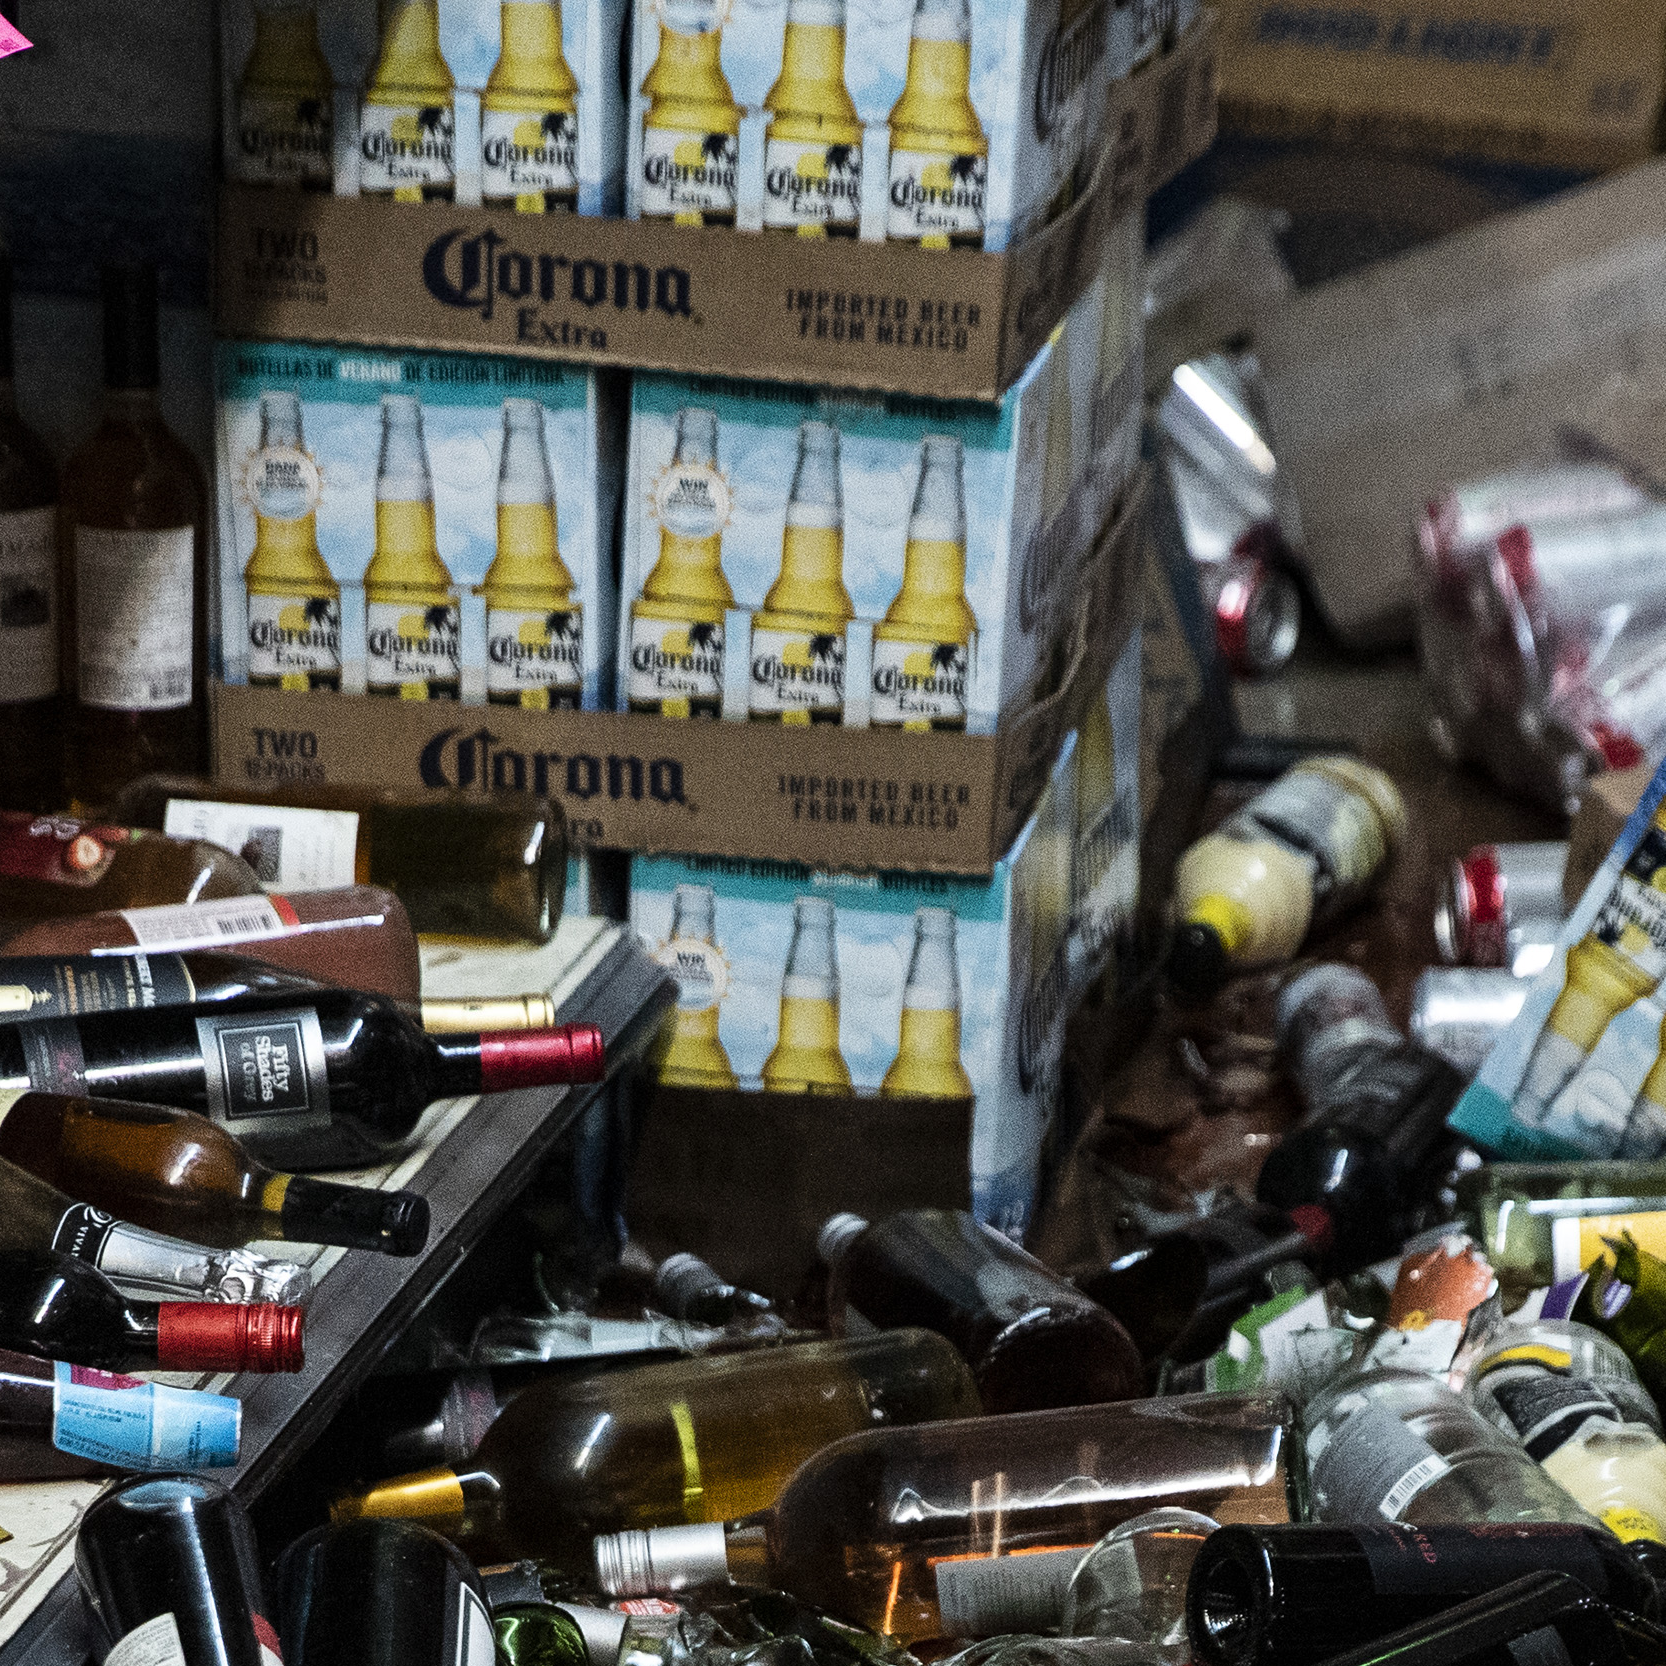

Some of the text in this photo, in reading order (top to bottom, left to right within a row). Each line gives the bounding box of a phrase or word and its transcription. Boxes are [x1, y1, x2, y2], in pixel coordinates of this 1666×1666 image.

[361, 129, 452, 162] Corona
[484, 135, 576, 167] Corona
[645, 154, 733, 189] Corona
[767, 164, 858, 198] Corona
[891, 175, 983, 207] Corona
[254, 228, 319, 258] TWO
[422, 226, 693, 321] Corona
[786, 289, 979, 326] IMPORTED BEER
[516, 306, 609, 351] Extra
[799, 316, 968, 352] FROM MEXICO
[679, 479, 708, 491] WIN
[250, 618, 339, 650] Corona
[369, 628, 458, 657] Corona
[490, 635, 579, 664] Corona
[633, 643, 721, 672] Corona
[752, 655, 842, 685] Corona
[873, 667, 963, 695] Corona
[254, 729, 317, 758] TWO
[419, 726, 687, 806] Corona
[779, 775, 970, 804] IMPORTED BEER
[794, 799, 958, 828] FROM MEXICO
[675, 951, 707, 966] WIN
[272, 1043, 291, 1092] Fifty
